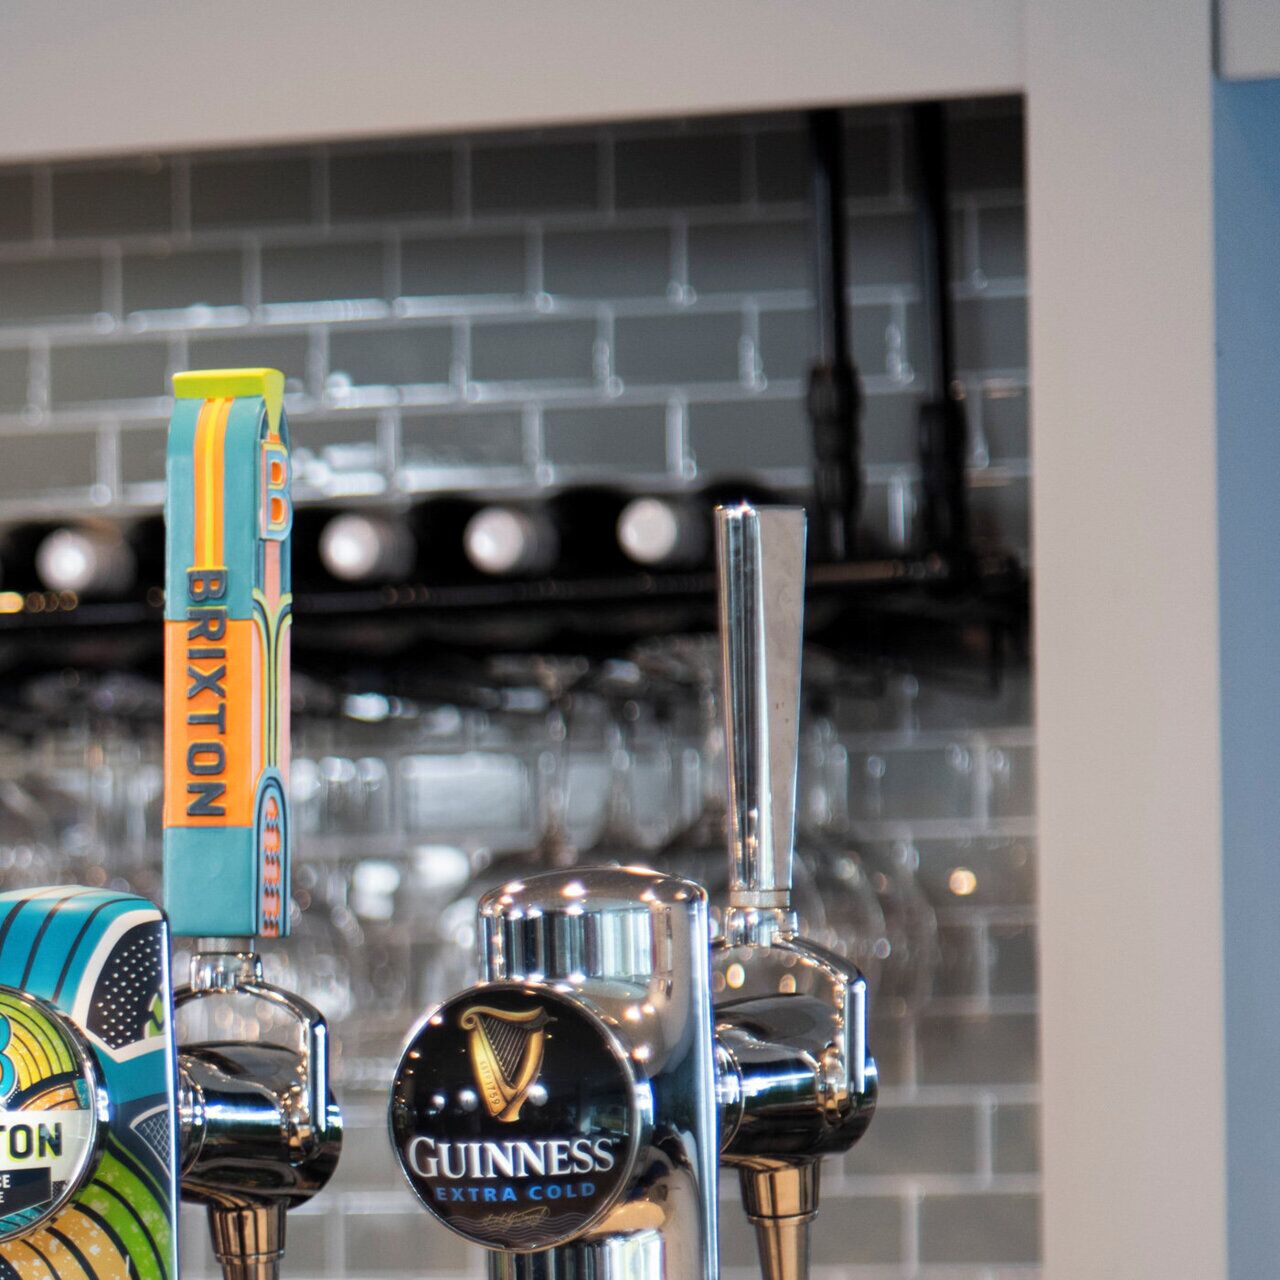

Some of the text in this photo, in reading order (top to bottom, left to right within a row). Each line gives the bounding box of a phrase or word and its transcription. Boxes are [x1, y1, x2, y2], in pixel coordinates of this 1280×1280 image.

[186, 568, 228, 818] BRIXTON
[408, 1136, 616, 1180] GUINNESS
[435, 1183, 596, 1202] EXTRA COLD
